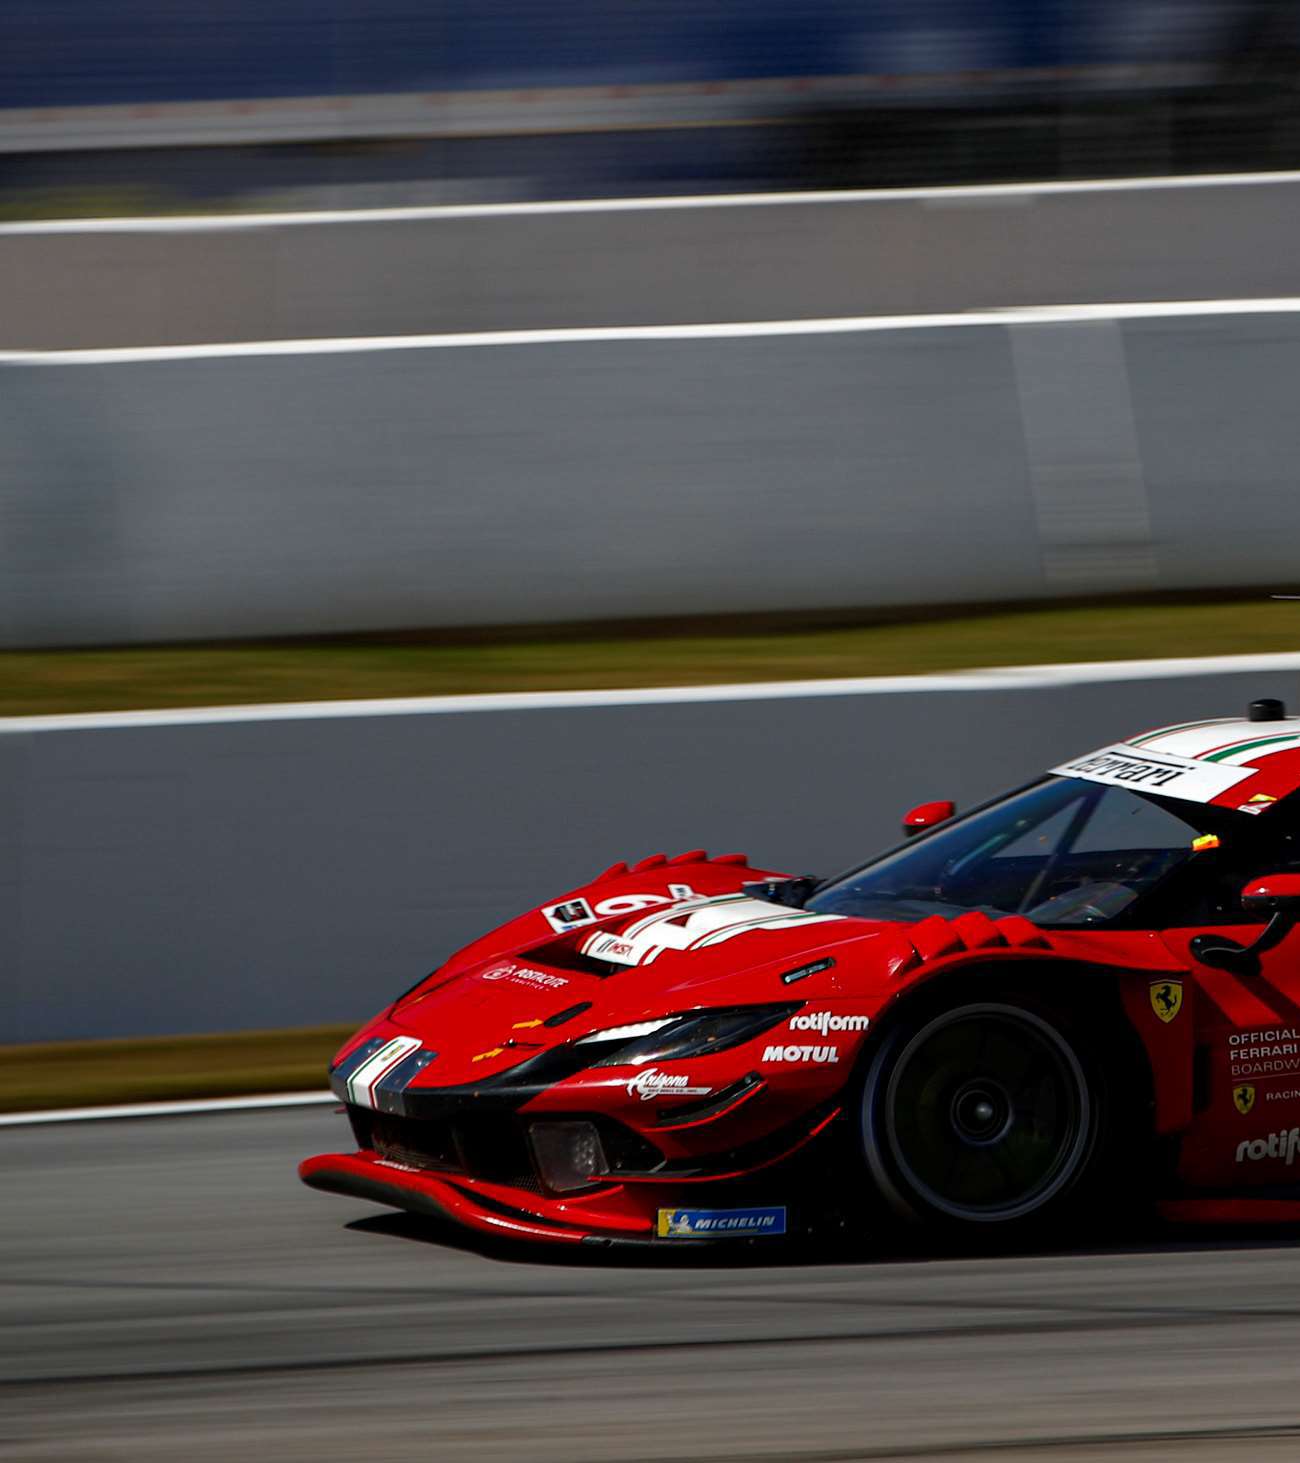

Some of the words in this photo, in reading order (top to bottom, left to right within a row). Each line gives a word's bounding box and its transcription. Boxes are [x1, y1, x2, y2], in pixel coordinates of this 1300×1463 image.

[789, 1010, 870, 1037] rotiform
[761, 1045, 840, 1063] MOTUL
[1229, 1043, 1299, 1061] FERRARI
[694, 1216, 777, 1231] MICHELIN
